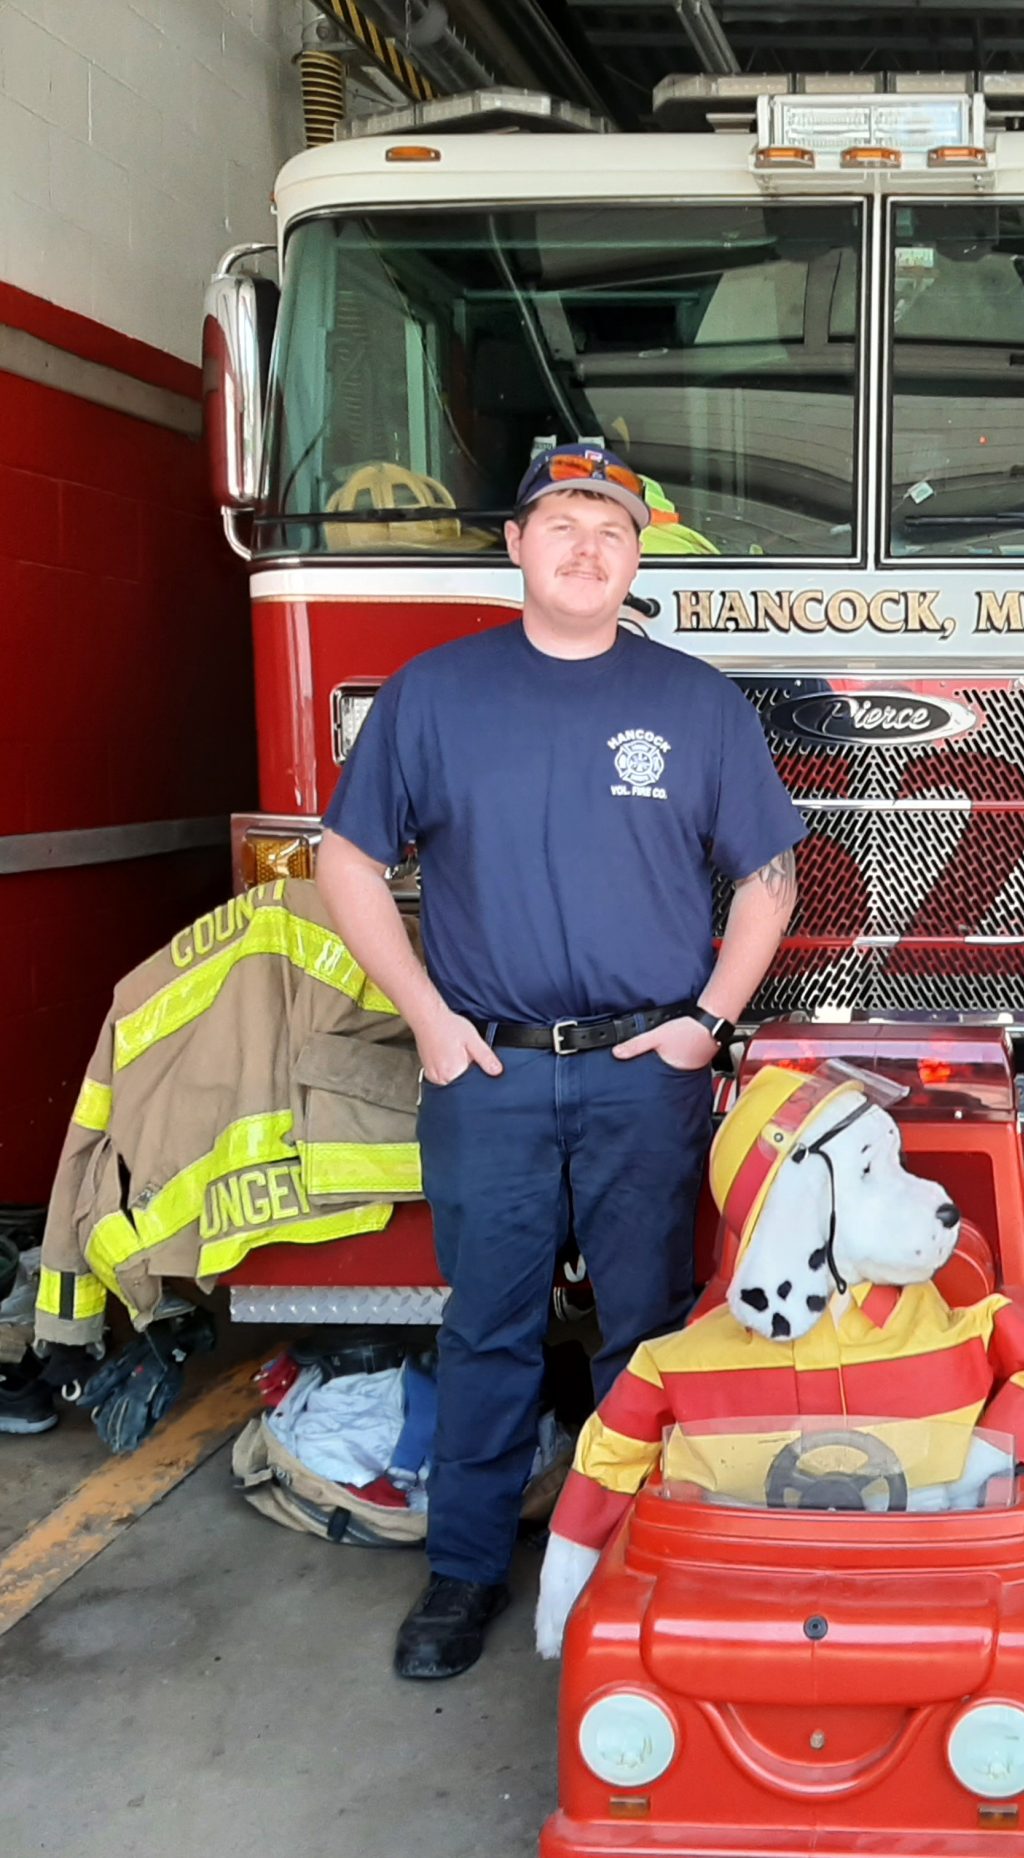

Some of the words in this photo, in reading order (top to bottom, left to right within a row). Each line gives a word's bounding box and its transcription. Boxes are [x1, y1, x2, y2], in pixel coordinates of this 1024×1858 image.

[675, 590, 955, 639] HANCOCK,
[814, 697, 932, 734] Pierce
[606, 728, 672, 753] HANCOCK
